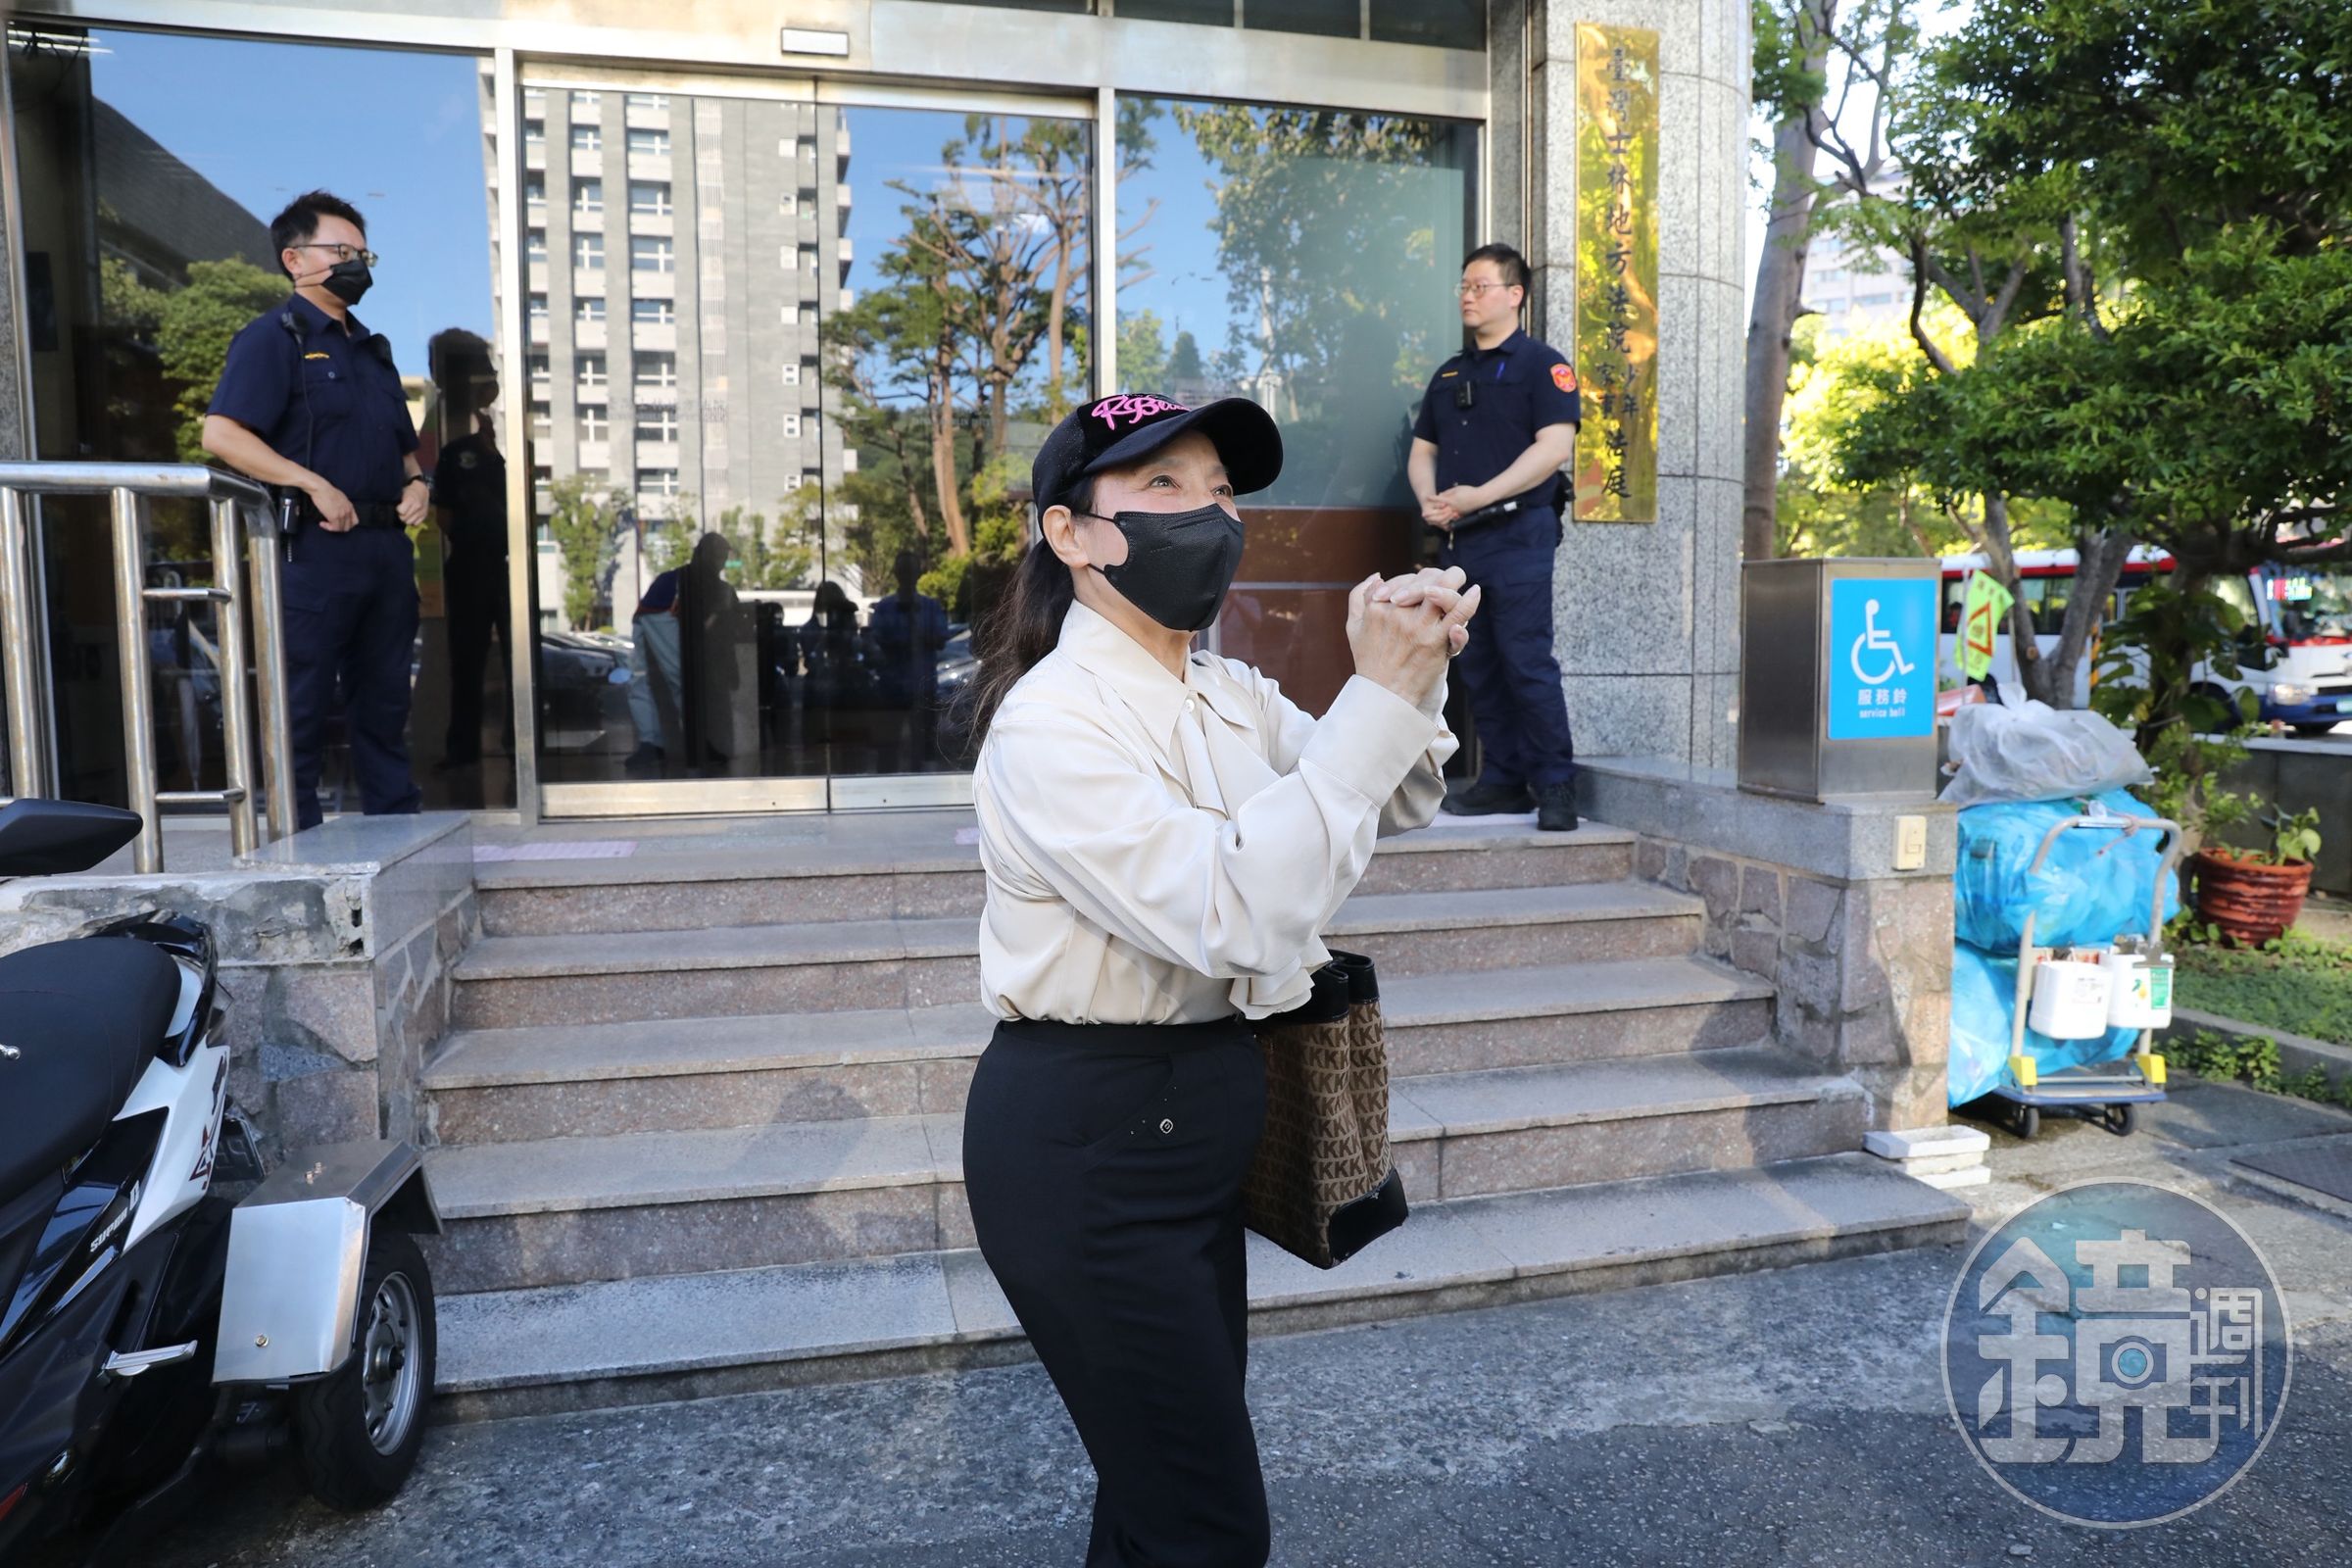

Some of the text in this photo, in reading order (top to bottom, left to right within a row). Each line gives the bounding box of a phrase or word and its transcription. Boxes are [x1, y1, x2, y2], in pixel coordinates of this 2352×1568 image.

[1858, 688, 1907, 706] 服務鈴
[90, 1206, 128, 1252] SUPER
